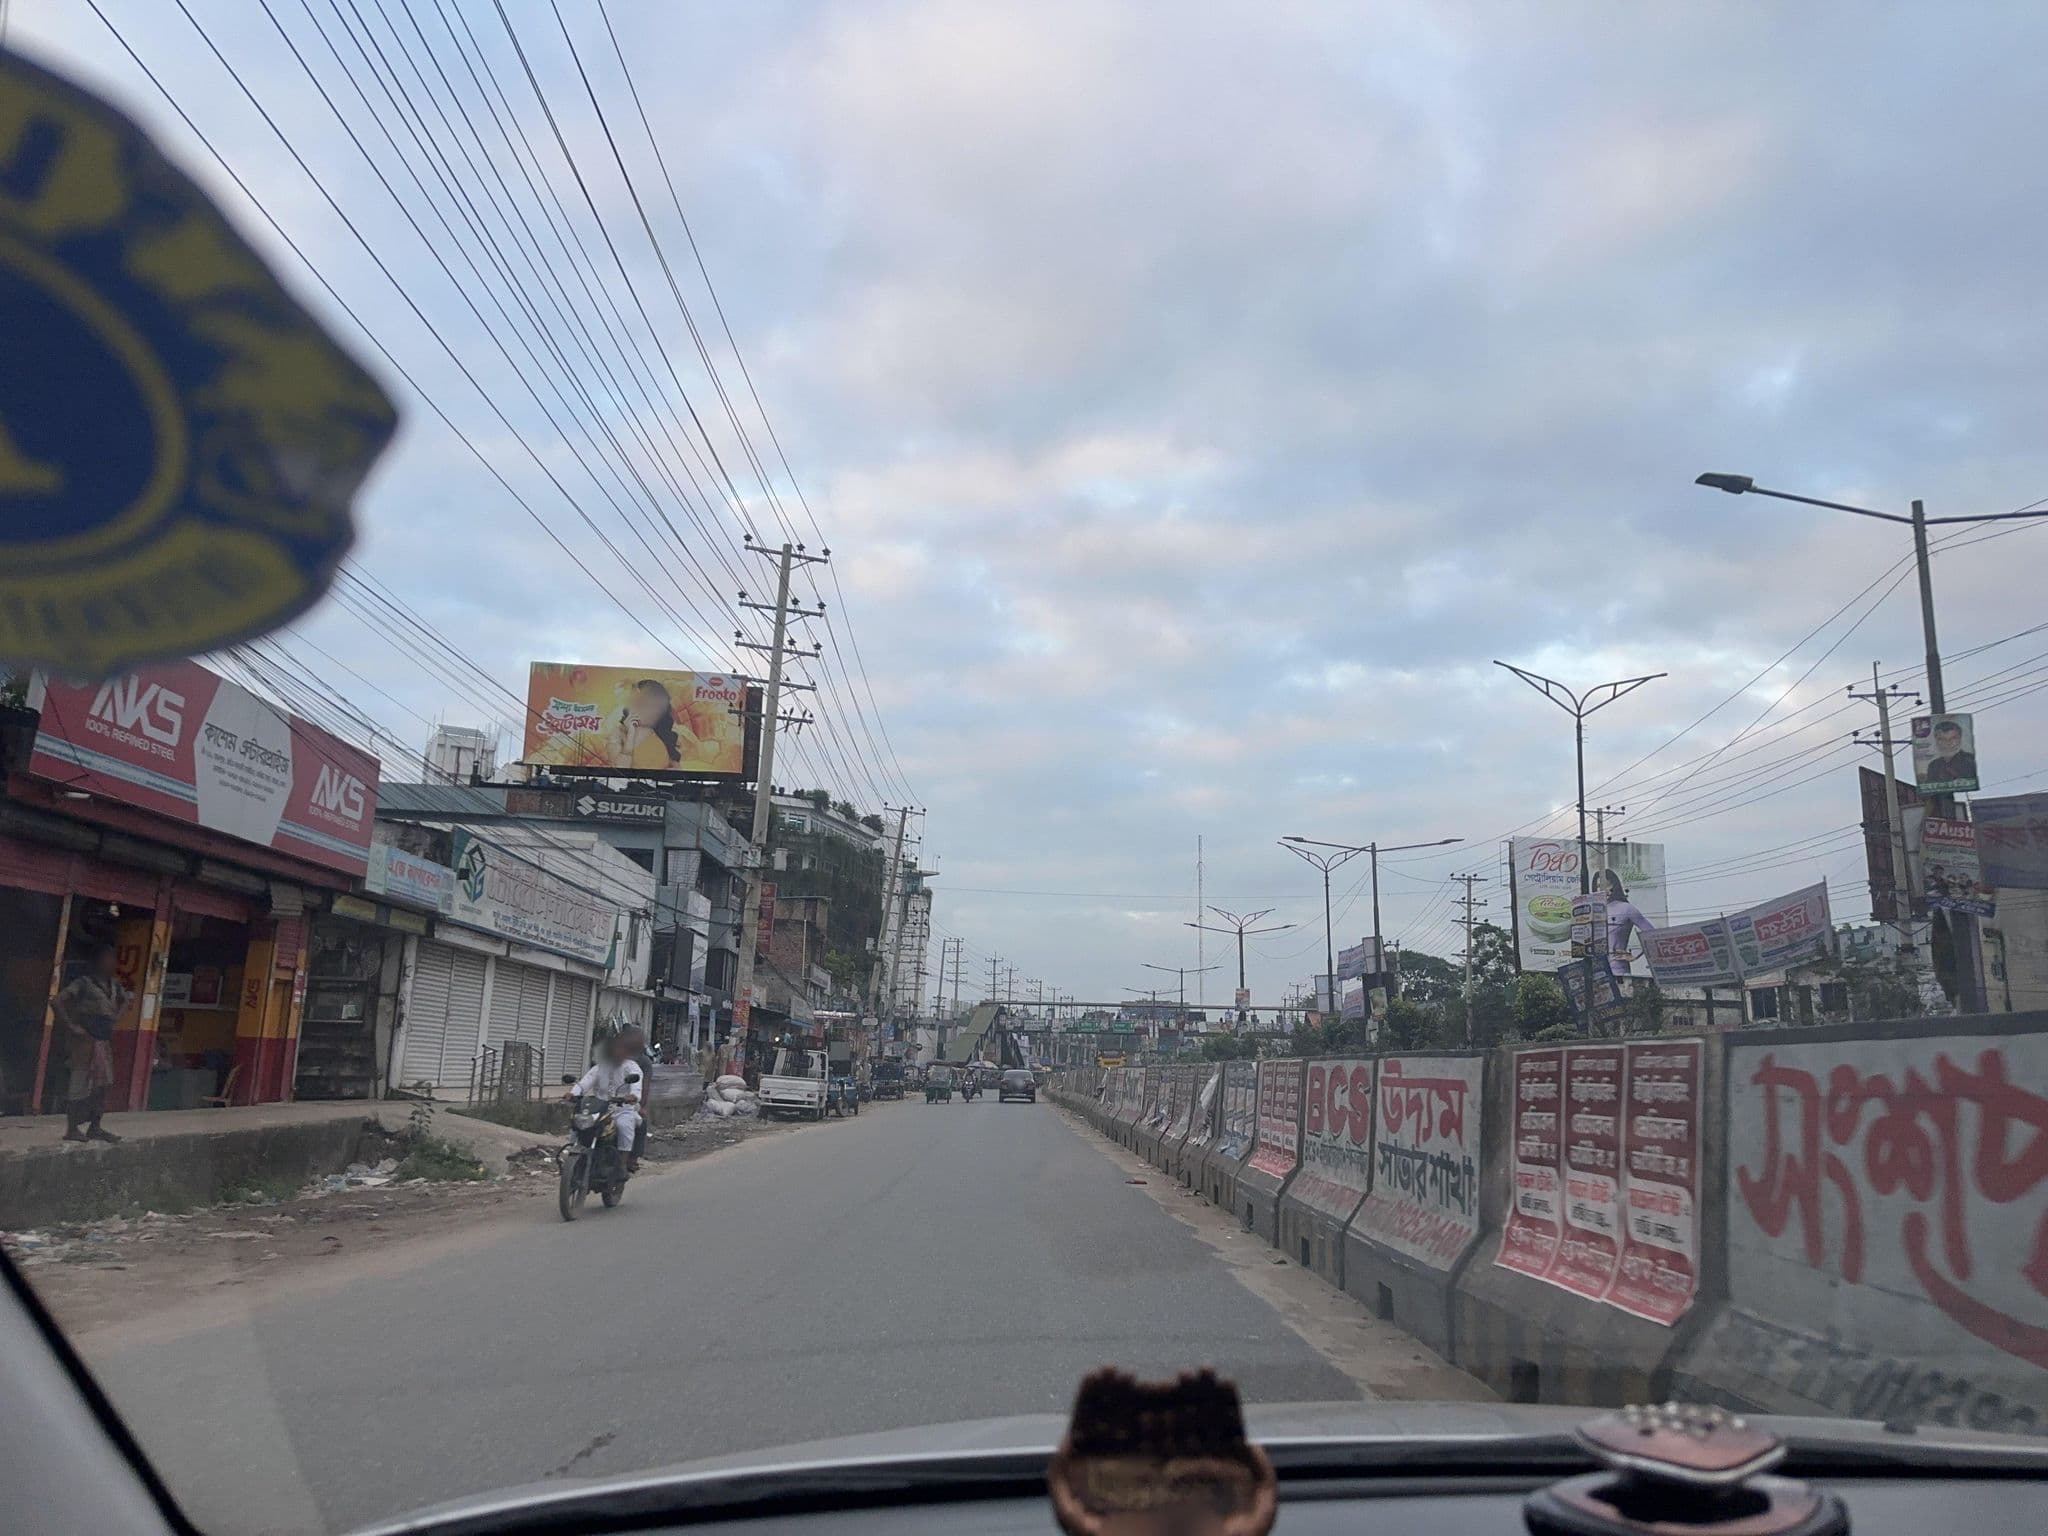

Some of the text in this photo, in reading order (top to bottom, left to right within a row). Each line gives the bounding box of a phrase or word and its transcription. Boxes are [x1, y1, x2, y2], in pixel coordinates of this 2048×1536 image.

[89, 673, 185, 747] AKS
[695, 686, 737, 701] Frooto
[111, 728, 150, 752] REFINED
[151, 742, 176, 762] STEEL
[205, 722, 238, 753] কাশেম
[311, 764, 366, 821] AKS
[597, 801, 665, 817] SUZUKI
[1307, 1064, 1371, 1147] BCS
[1380, 1059, 1468, 1148] উদ্যম
[1378, 1139, 1428, 1204] সাভার
